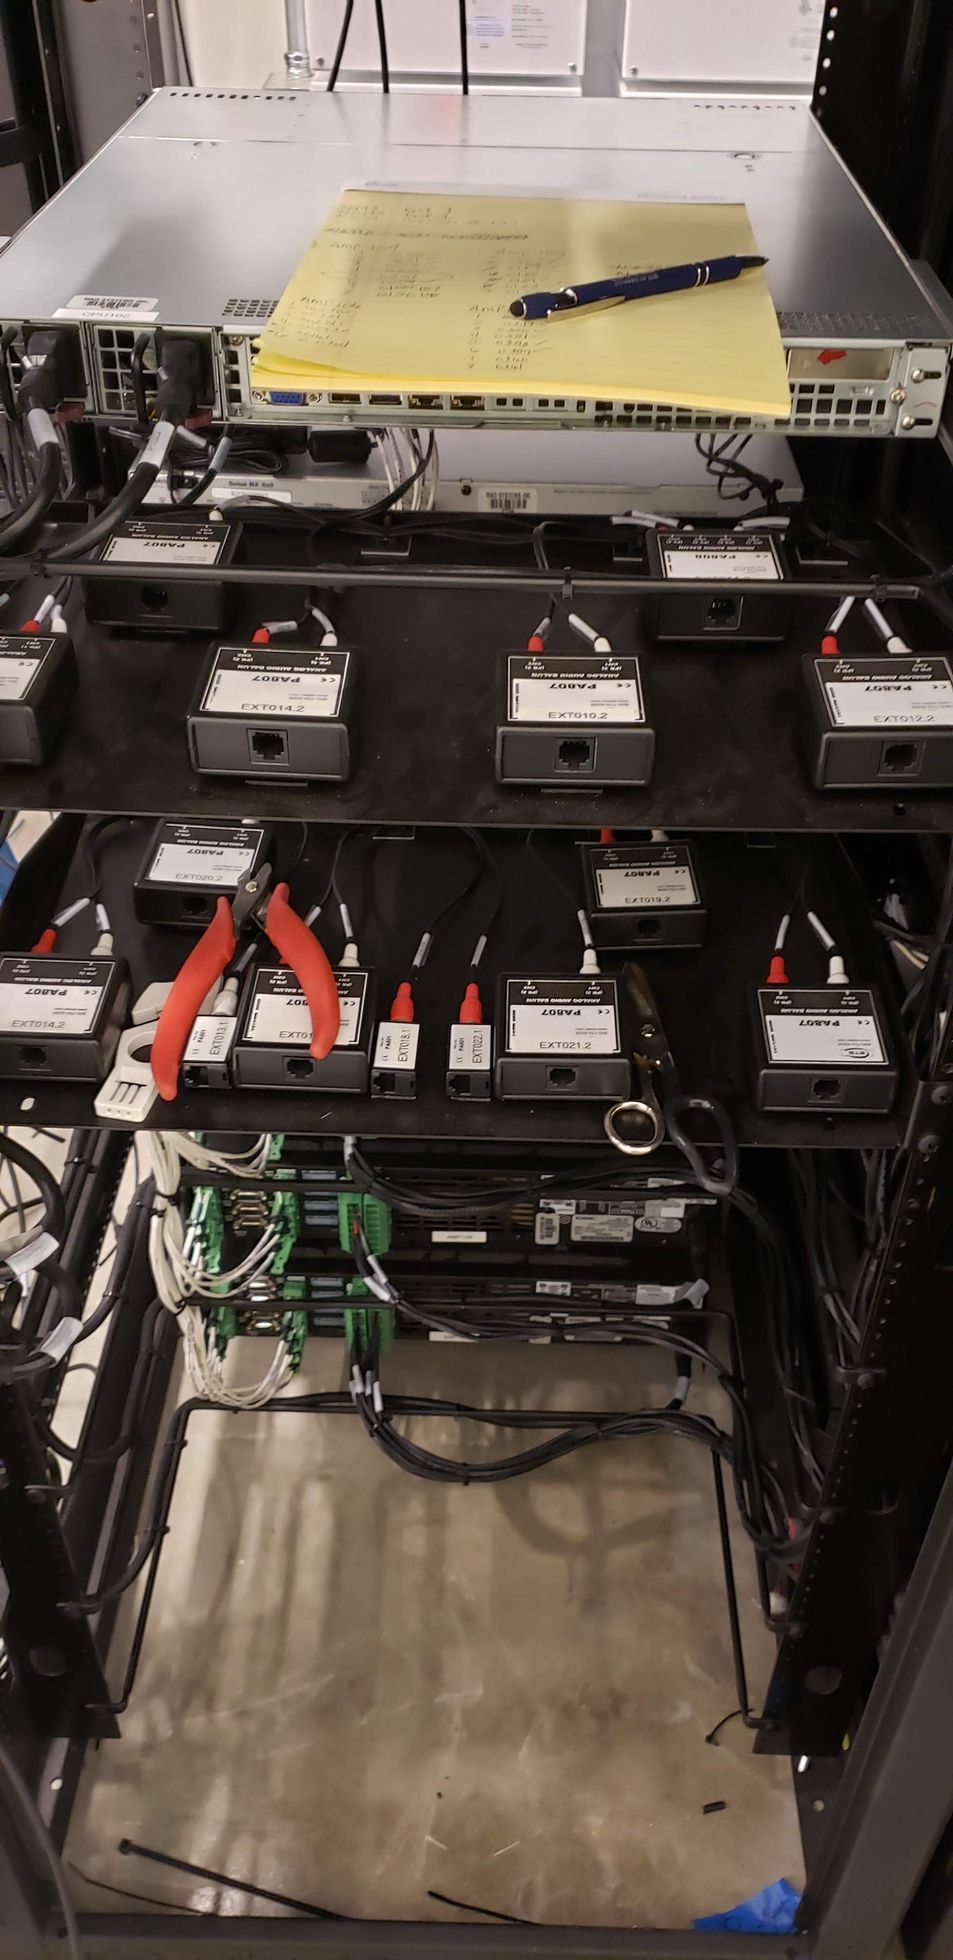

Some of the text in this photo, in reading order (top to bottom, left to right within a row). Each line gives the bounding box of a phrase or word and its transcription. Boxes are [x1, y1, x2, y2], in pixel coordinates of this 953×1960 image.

[241, 703, 304, 713] EXT014.2
[548, 712, 607, 720] EXT010.2
[873, 715, 934, 723] EXT012.2
[175, 873, 223, 881] EXT020.2
[25, 988, 67, 996] PA807
[11, 1020, 65, 1029] EXT014.2
[209, 1022, 228, 1055] EXT013.1
[279, 1031, 312, 1039] EXT01
[398, 1029, 411, 1062] EXT018.1
[472, 1030, 483, 1063] EXT022.1
[539, 1041, 591, 1049] EXT021.2
